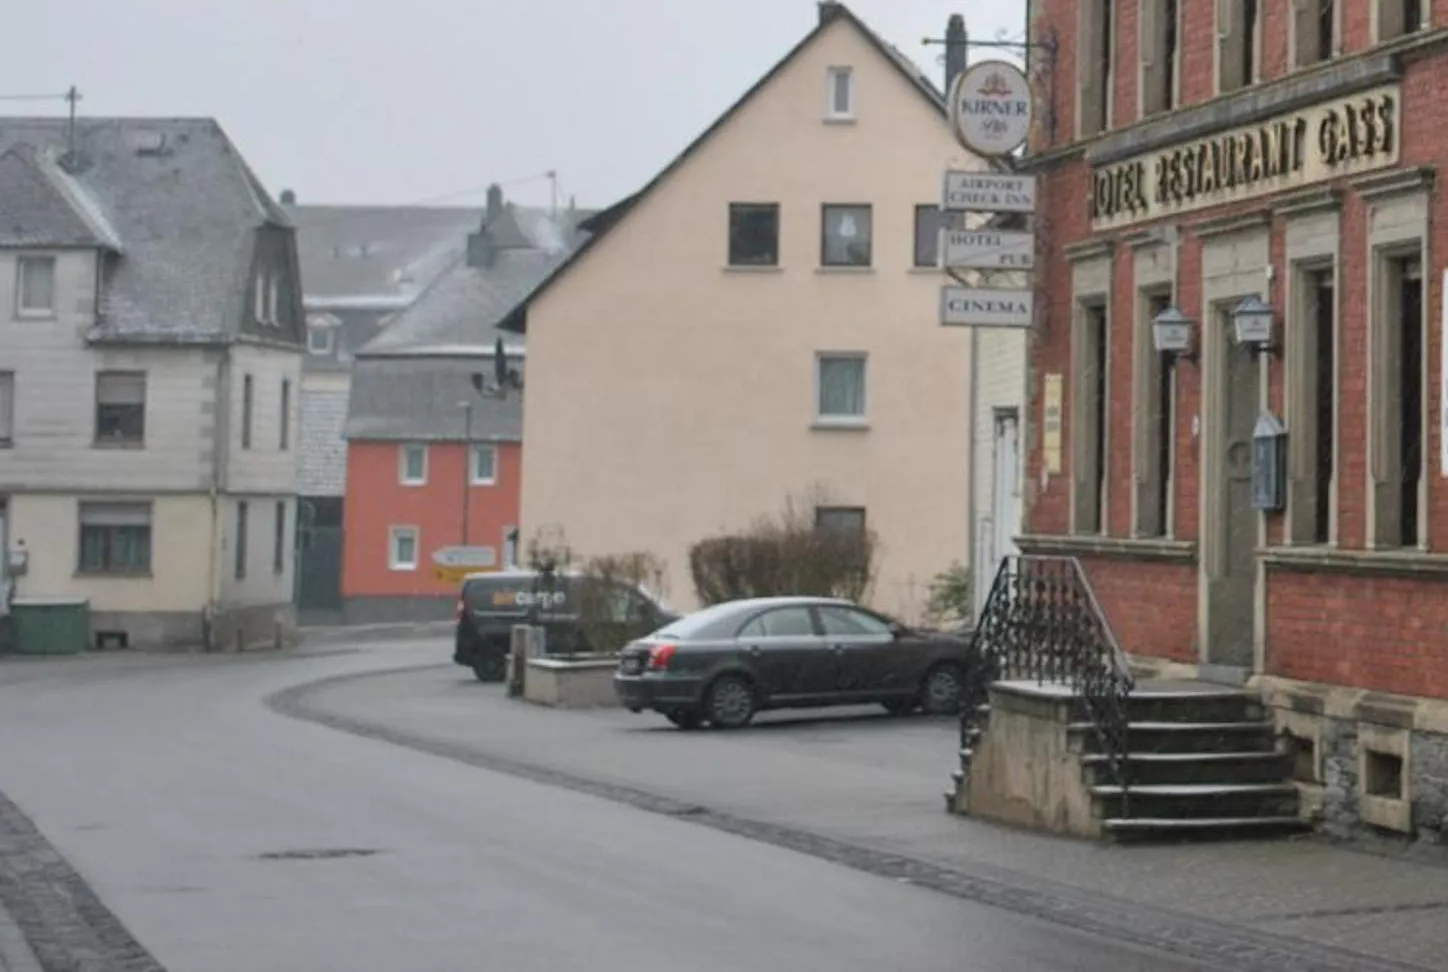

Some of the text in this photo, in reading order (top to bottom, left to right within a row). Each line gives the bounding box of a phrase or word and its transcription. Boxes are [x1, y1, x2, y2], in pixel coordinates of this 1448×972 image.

[1155, 117, 1306, 205] RESTAURANT
[1319, 95, 1393, 167] GASS
[960, 177, 1023, 190] AIRPORT
[950, 191, 1032, 205] CHECK INN
[951, 233, 1001, 246] HOTEL
[948, 298, 1028, 314] CINEMA
